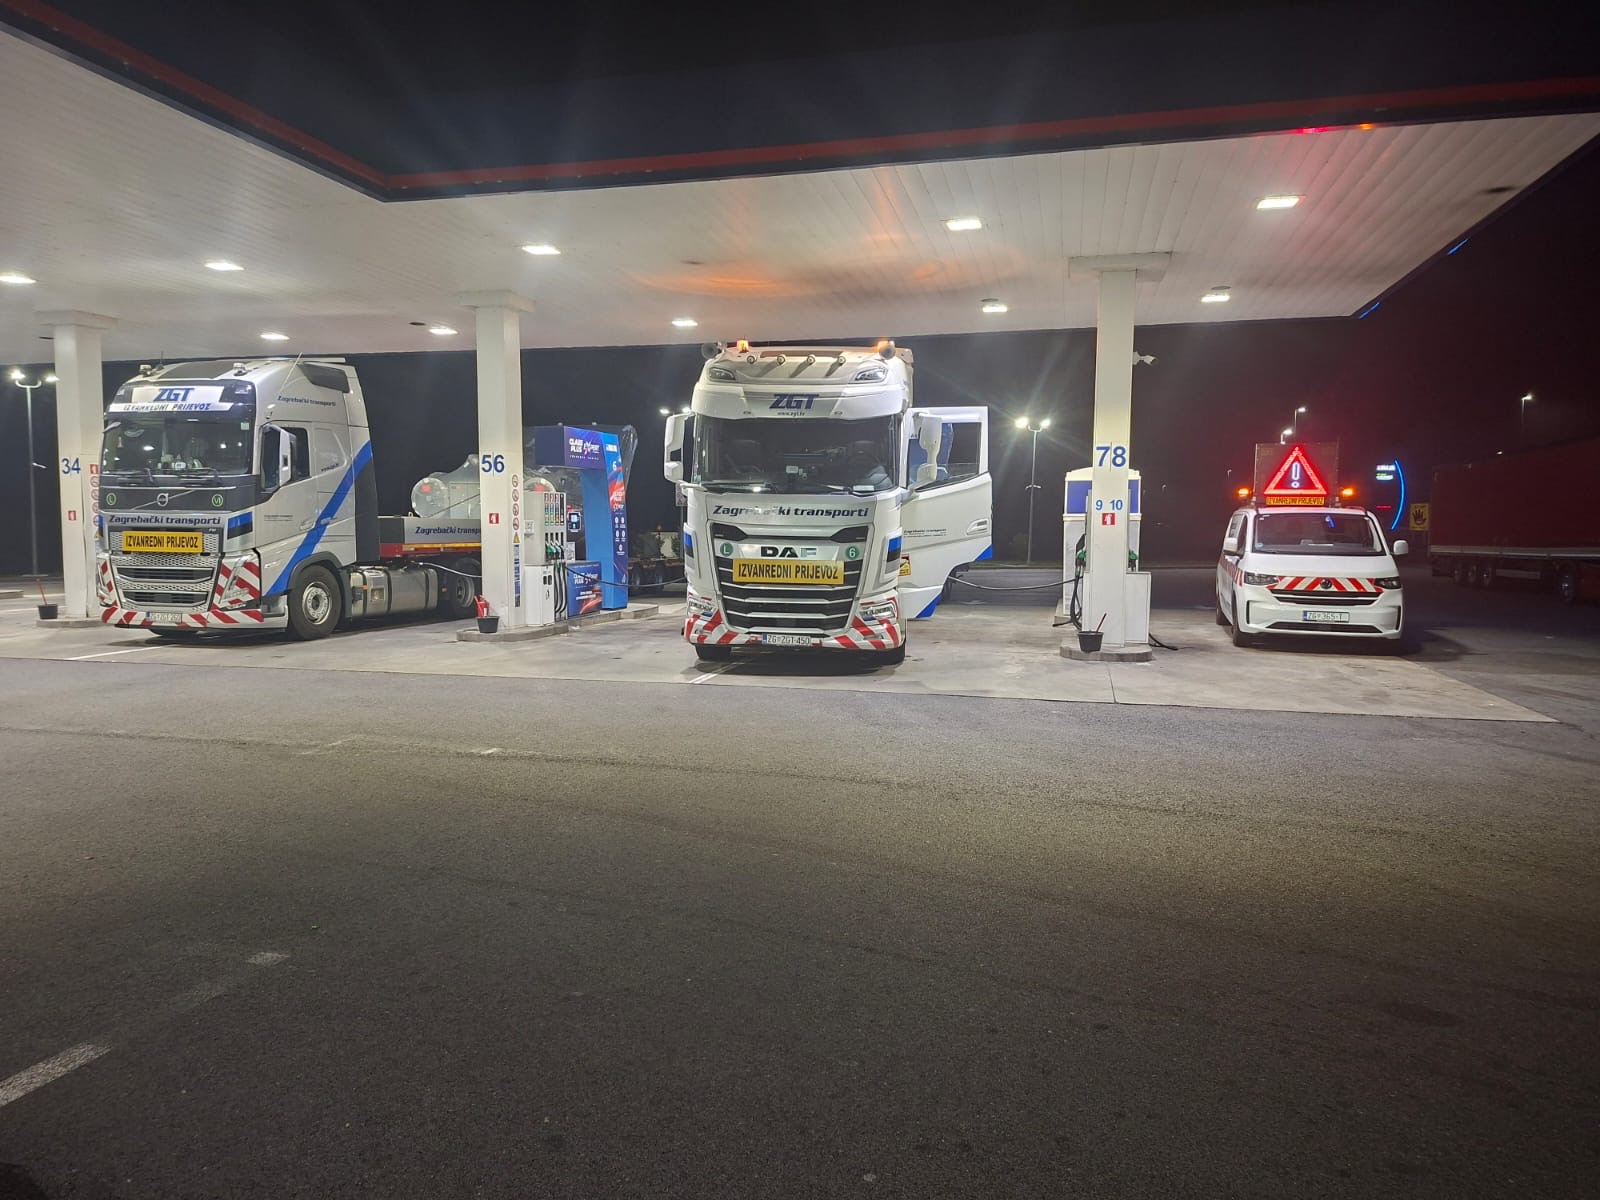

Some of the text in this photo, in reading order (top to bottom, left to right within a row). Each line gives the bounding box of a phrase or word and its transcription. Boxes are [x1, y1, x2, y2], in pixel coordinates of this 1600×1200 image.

[153, 387, 194, 401] ZGT
[173, 403, 211, 411] PRIJEVOZ
[769, 393, 819, 409] ZGT
[1096, 500, 1123, 511] 9 10
[713, 505, 869, 519] Zagreački transporti
[109, 514, 221, 526] Zagrebački transporti
[415, 526, 457, 536] Zagrebački
[126, 535, 199, 549] IZVANREDNI PRIJEVOZ
[723, 543, 730, 555] L
[760, 546, 817, 558] DAF
[848, 548, 856, 559] 6
[738, 564, 839, 580] IZVANREDNI PRIJEVOZ
[767, 634, 777, 644] ZG
